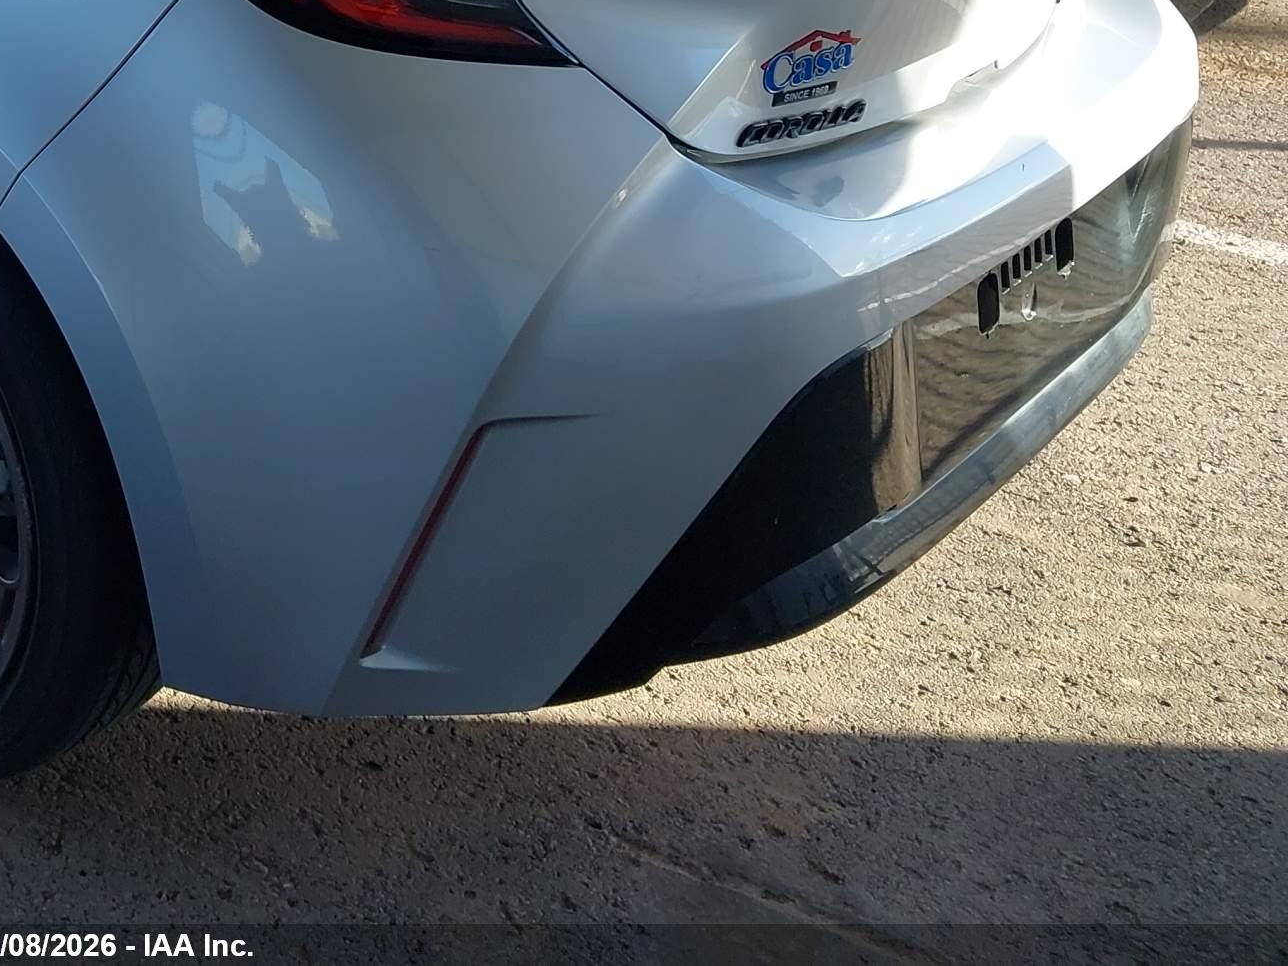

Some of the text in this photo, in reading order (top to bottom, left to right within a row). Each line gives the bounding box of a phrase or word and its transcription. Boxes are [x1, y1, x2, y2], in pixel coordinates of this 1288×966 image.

[763, 42, 855, 94] Casa
[784, 89, 810, 102] SINCE
[736, 98, 867, 147] COROLLA
